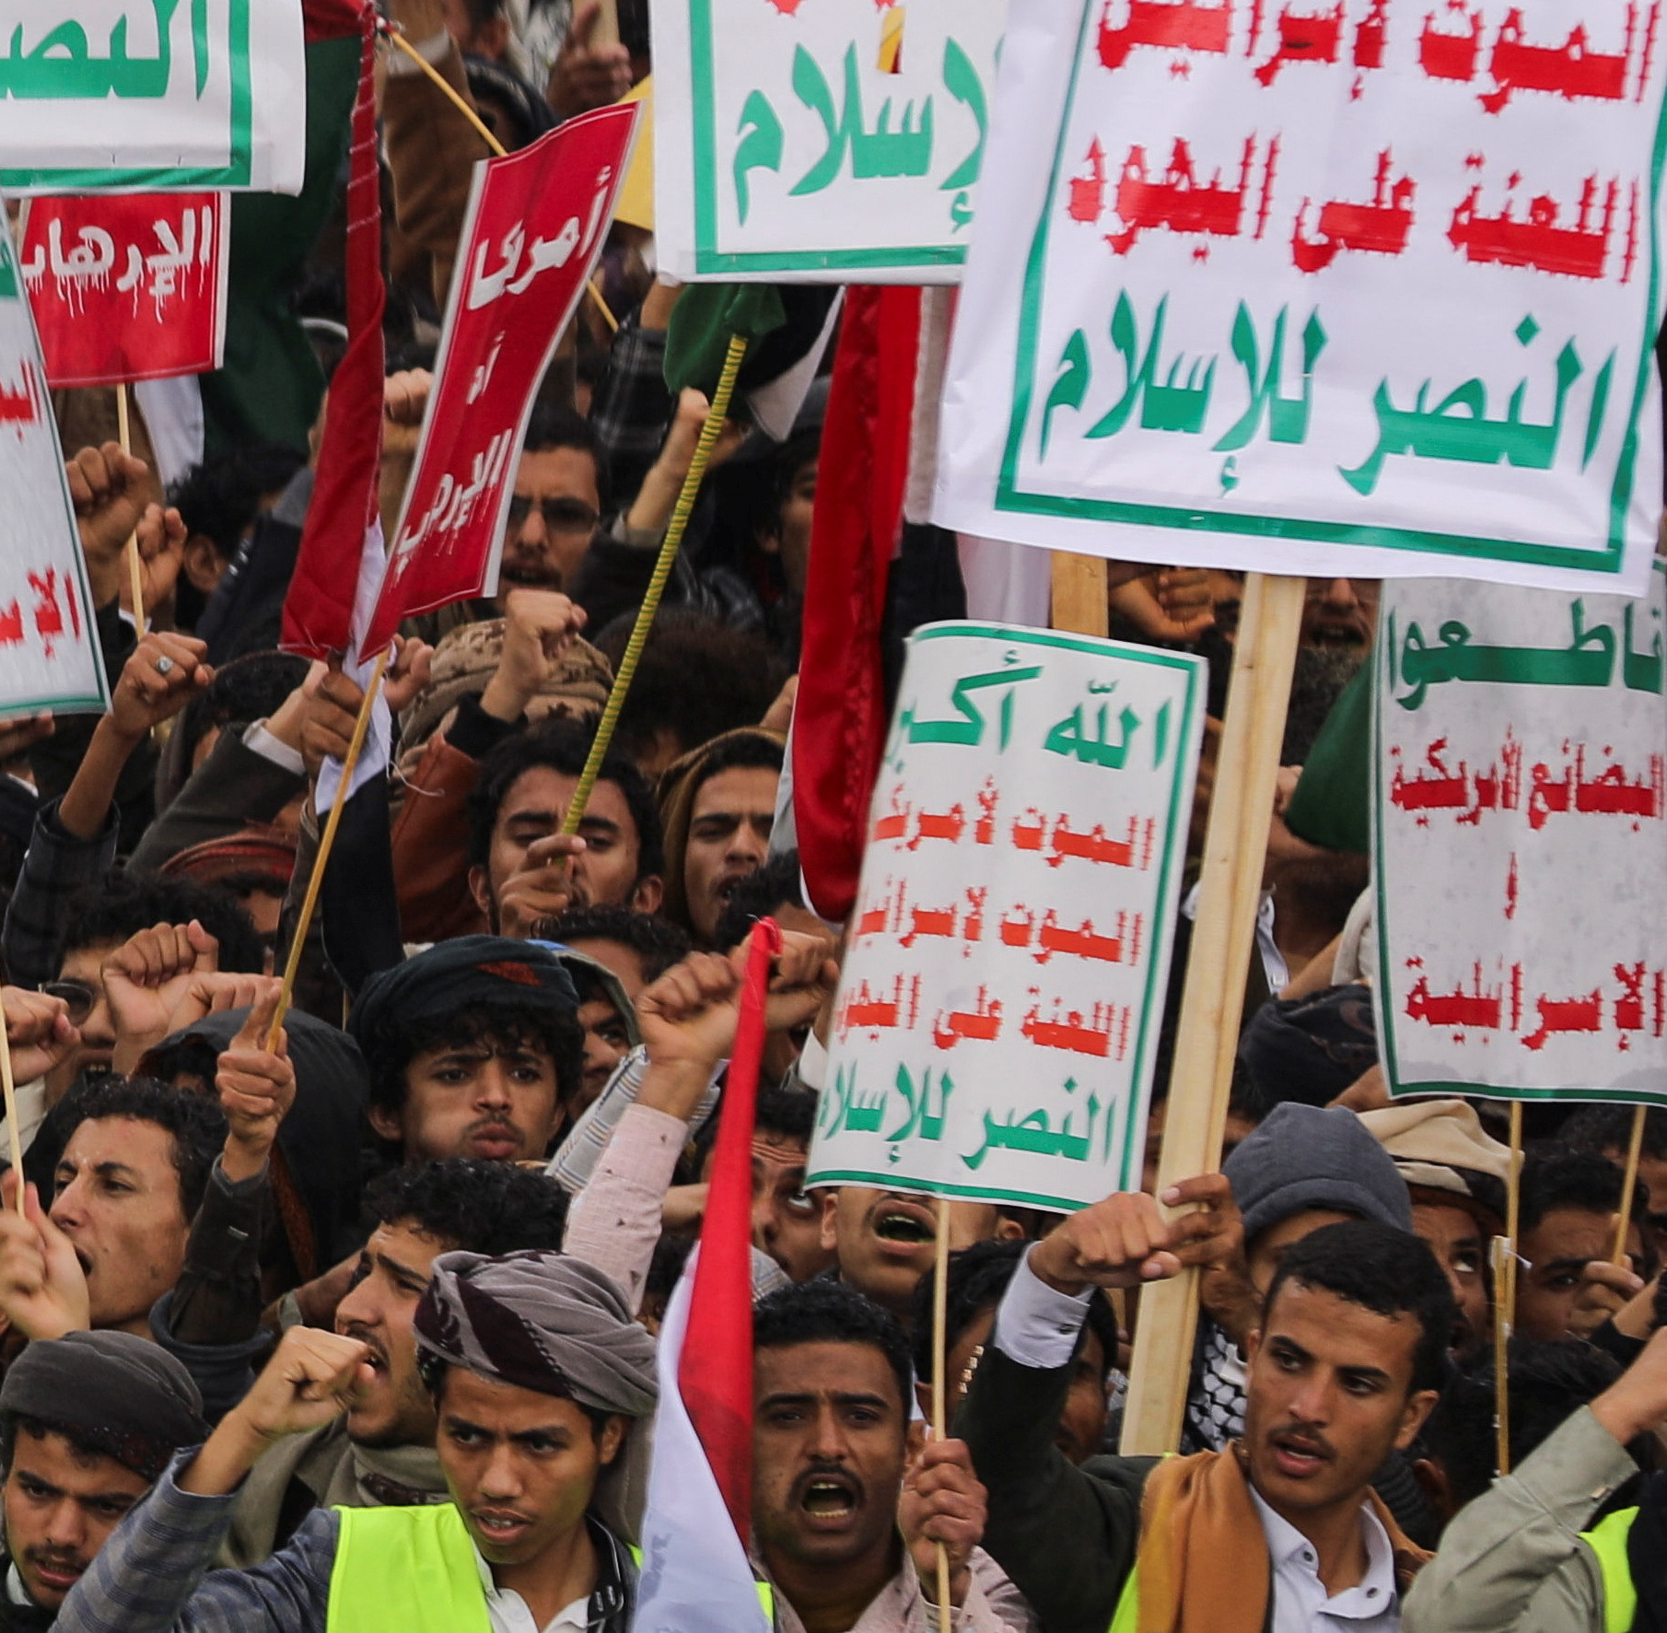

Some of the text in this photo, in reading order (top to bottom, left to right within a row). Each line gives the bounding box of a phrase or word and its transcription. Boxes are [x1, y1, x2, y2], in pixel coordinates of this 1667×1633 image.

[1418, 0, 1659, 114] الموت
[1068, 137, 1638, 283] اللعنة على اليهود
[1042, 293, 1614, 495] النصر للإسلام
[873, 773, 1154, 868] الموت لأمريك
[1390, 724, 1665, 831] البضائع الأمريكية
[999, 904, 1142, 964] الموت
[932, 986, 1003, 1050] على
[1020, 987, 1130, 1058] اللعنة
[1405, 958, 1665, 1051] الإسرائيلية
[961, 1076, 1115, 1169] النصر
